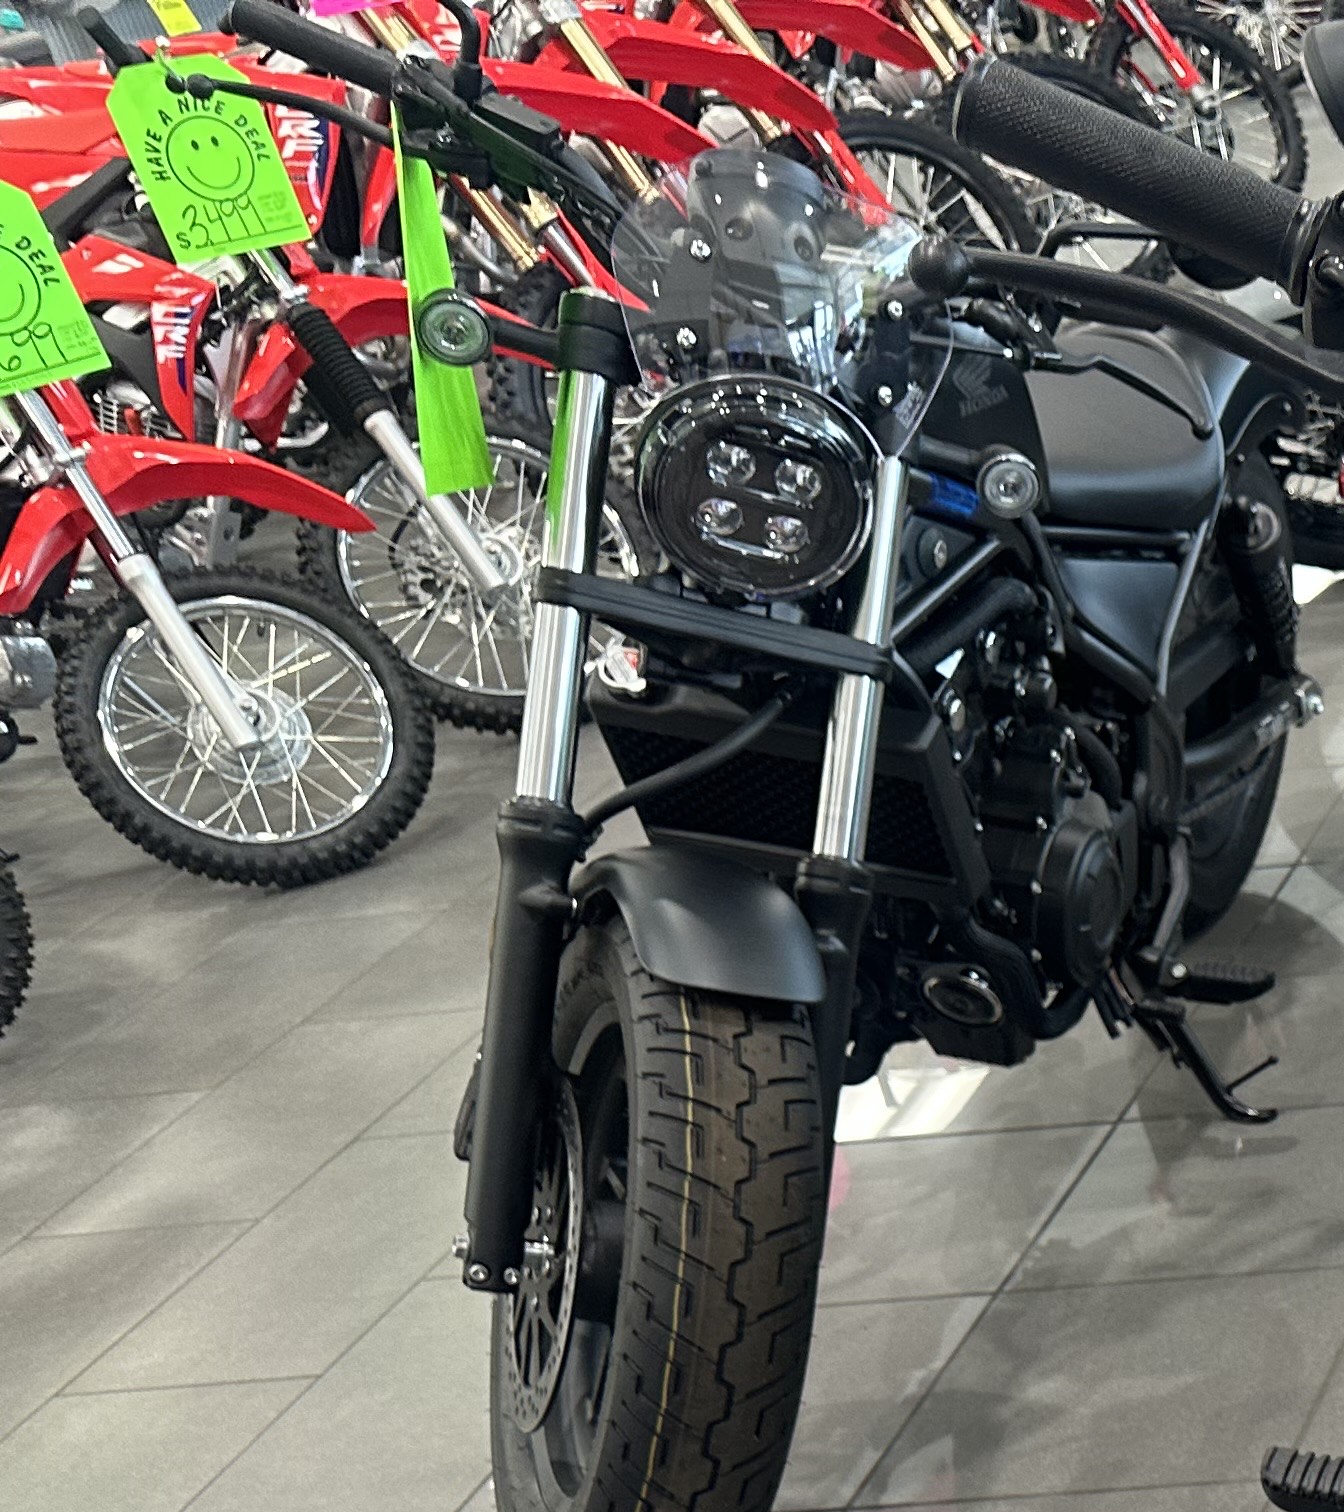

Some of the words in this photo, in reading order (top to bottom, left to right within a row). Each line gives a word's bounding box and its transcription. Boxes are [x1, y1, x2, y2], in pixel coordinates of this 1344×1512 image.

[157, 108, 174, 127] A
[177, 96, 226, 116] NICE
[144, 127, 172, 182] HAVE
[234, 114, 271, 163] DEAL
[15, 235, 60, 287] DEAL
[0, 322, 69, 372] 699
